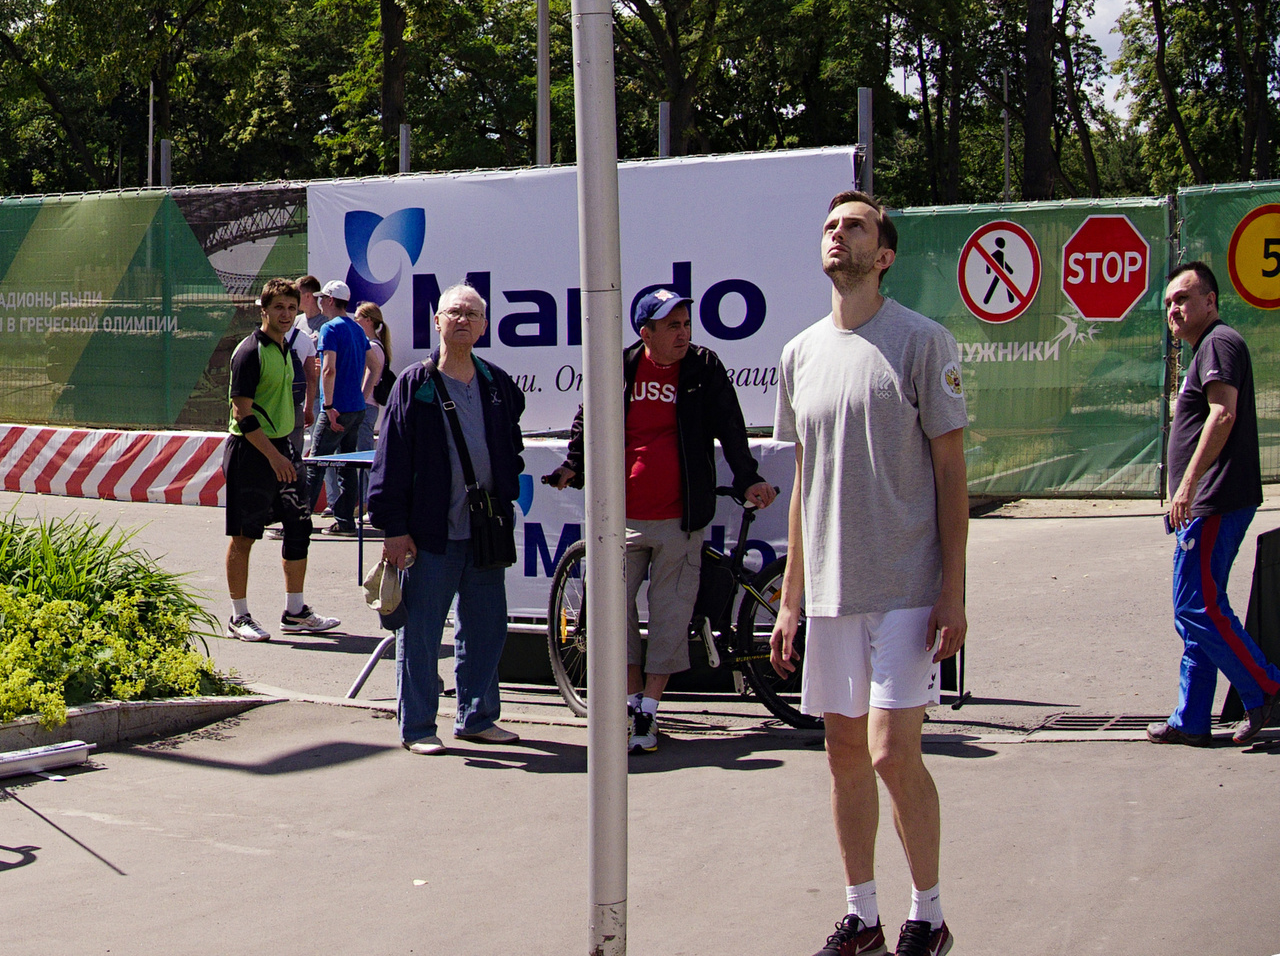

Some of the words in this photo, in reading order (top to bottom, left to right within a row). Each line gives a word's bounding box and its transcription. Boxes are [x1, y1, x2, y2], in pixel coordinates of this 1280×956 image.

[1066, 251, 1143, 284] STOP
[60, 290, 103, 308] БЫЛИ
[7, 317, 16, 333] В
[20, 312, 99, 333] ГРЕЧЕСКОЙ
[103, 315, 179, 333] ОЛИМПИИ
[630, 381, 677, 404] USS
